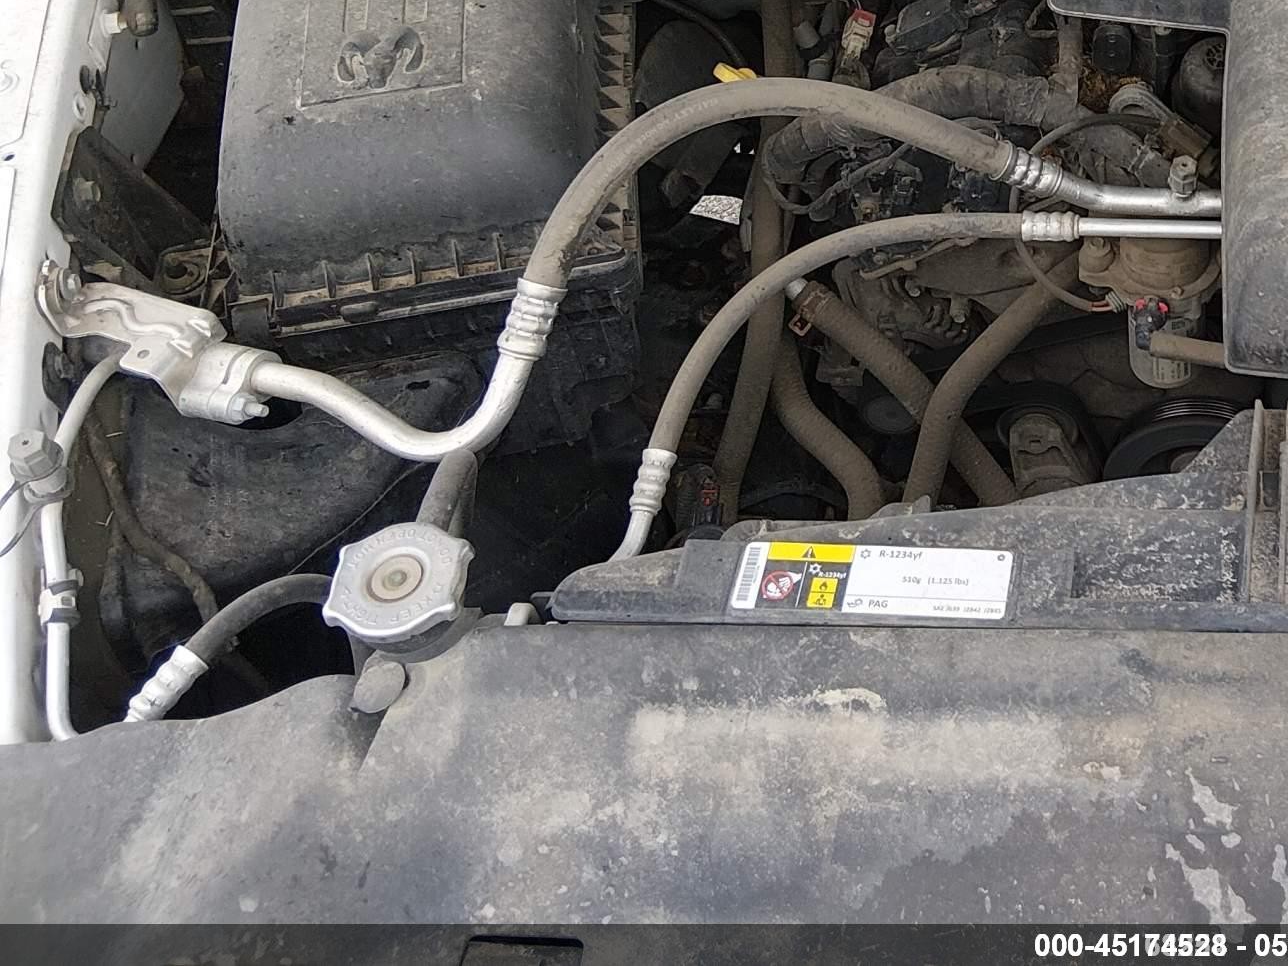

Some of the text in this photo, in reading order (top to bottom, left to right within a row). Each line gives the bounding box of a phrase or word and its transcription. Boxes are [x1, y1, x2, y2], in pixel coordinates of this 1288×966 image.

[878, 549, 923, 561] R-1234yf
[901, 575, 922, 585] 510g
[868, 598, 889, 609] PAG
